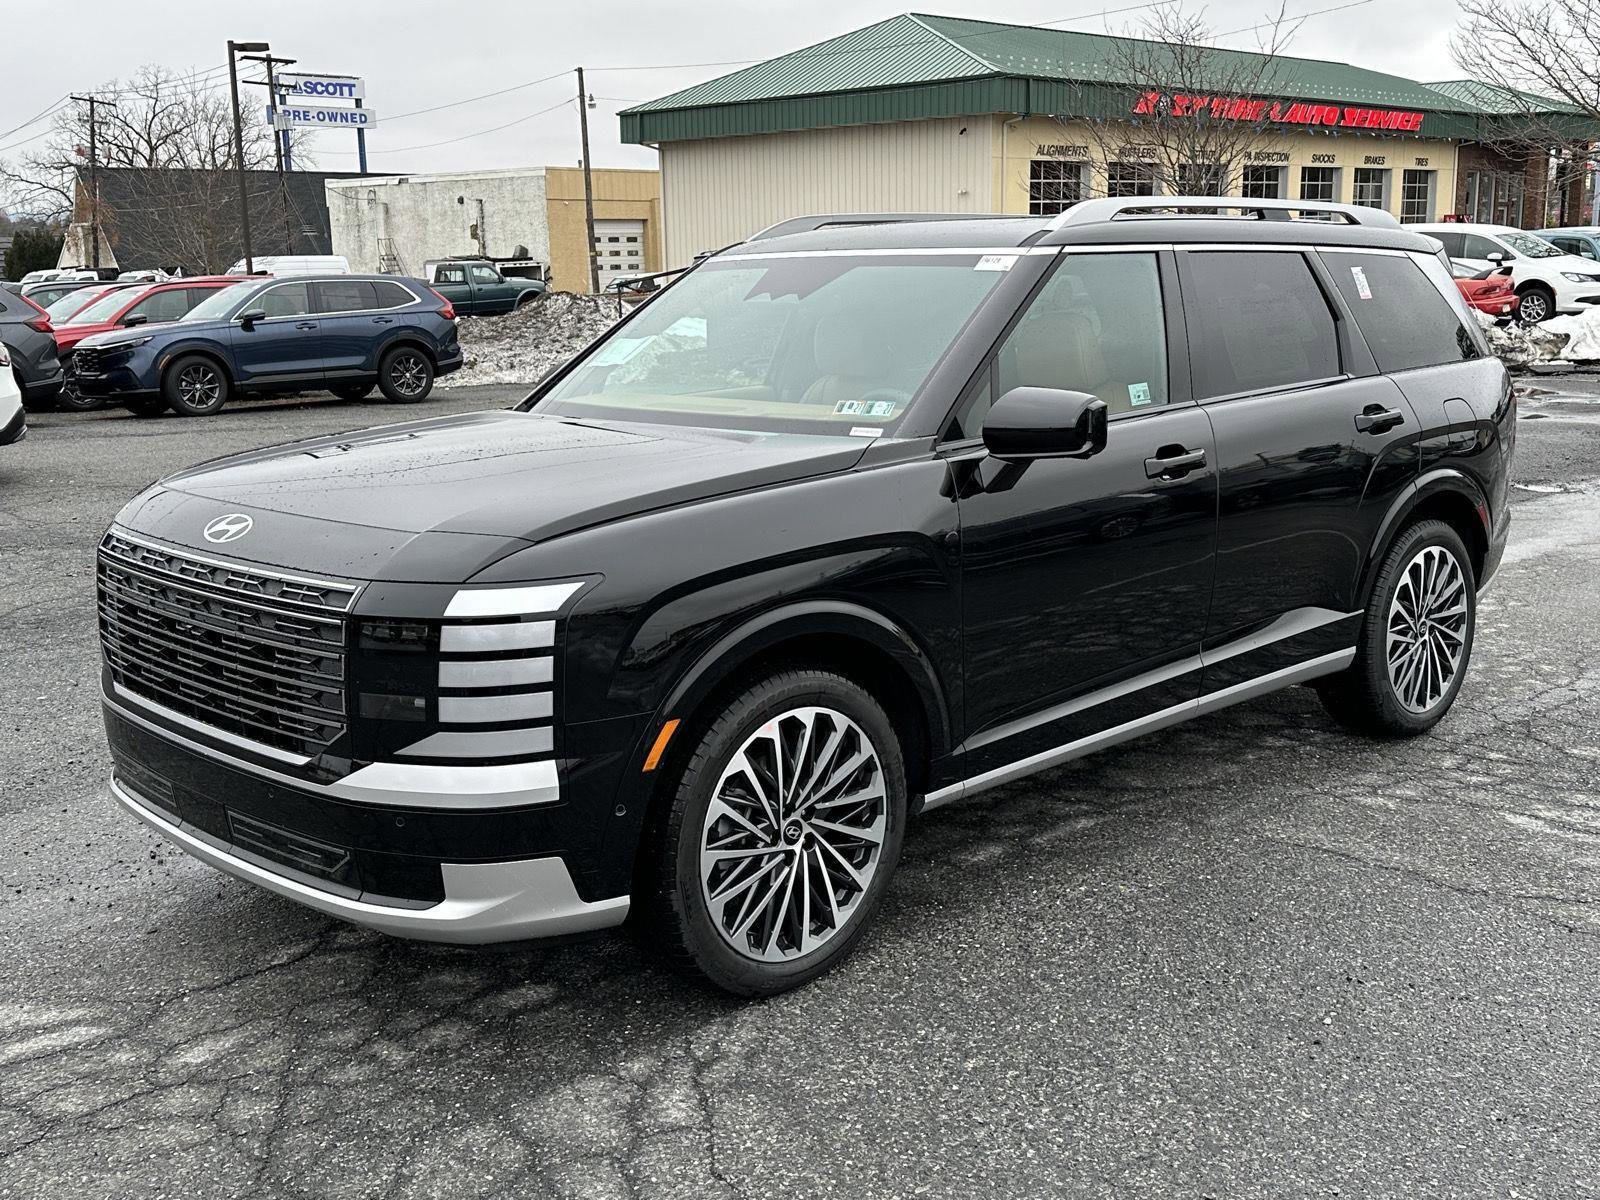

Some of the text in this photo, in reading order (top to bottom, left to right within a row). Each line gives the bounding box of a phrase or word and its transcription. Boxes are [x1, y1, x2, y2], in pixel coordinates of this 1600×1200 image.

[303, 80, 356, 97] SCOTT
[282, 109, 368, 124] PRE-OWNED
[1282, 102, 1339, 126] AUTO
[1339, 107, 1424, 131] SERVICE
[1036, 144, 1089, 157] ALIGNMENTS
[1311, 153, 1335, 164] SHOCKS
[1364, 155, 1385, 165] BRAKES
[1414, 157, 1429, 166] TIRES
